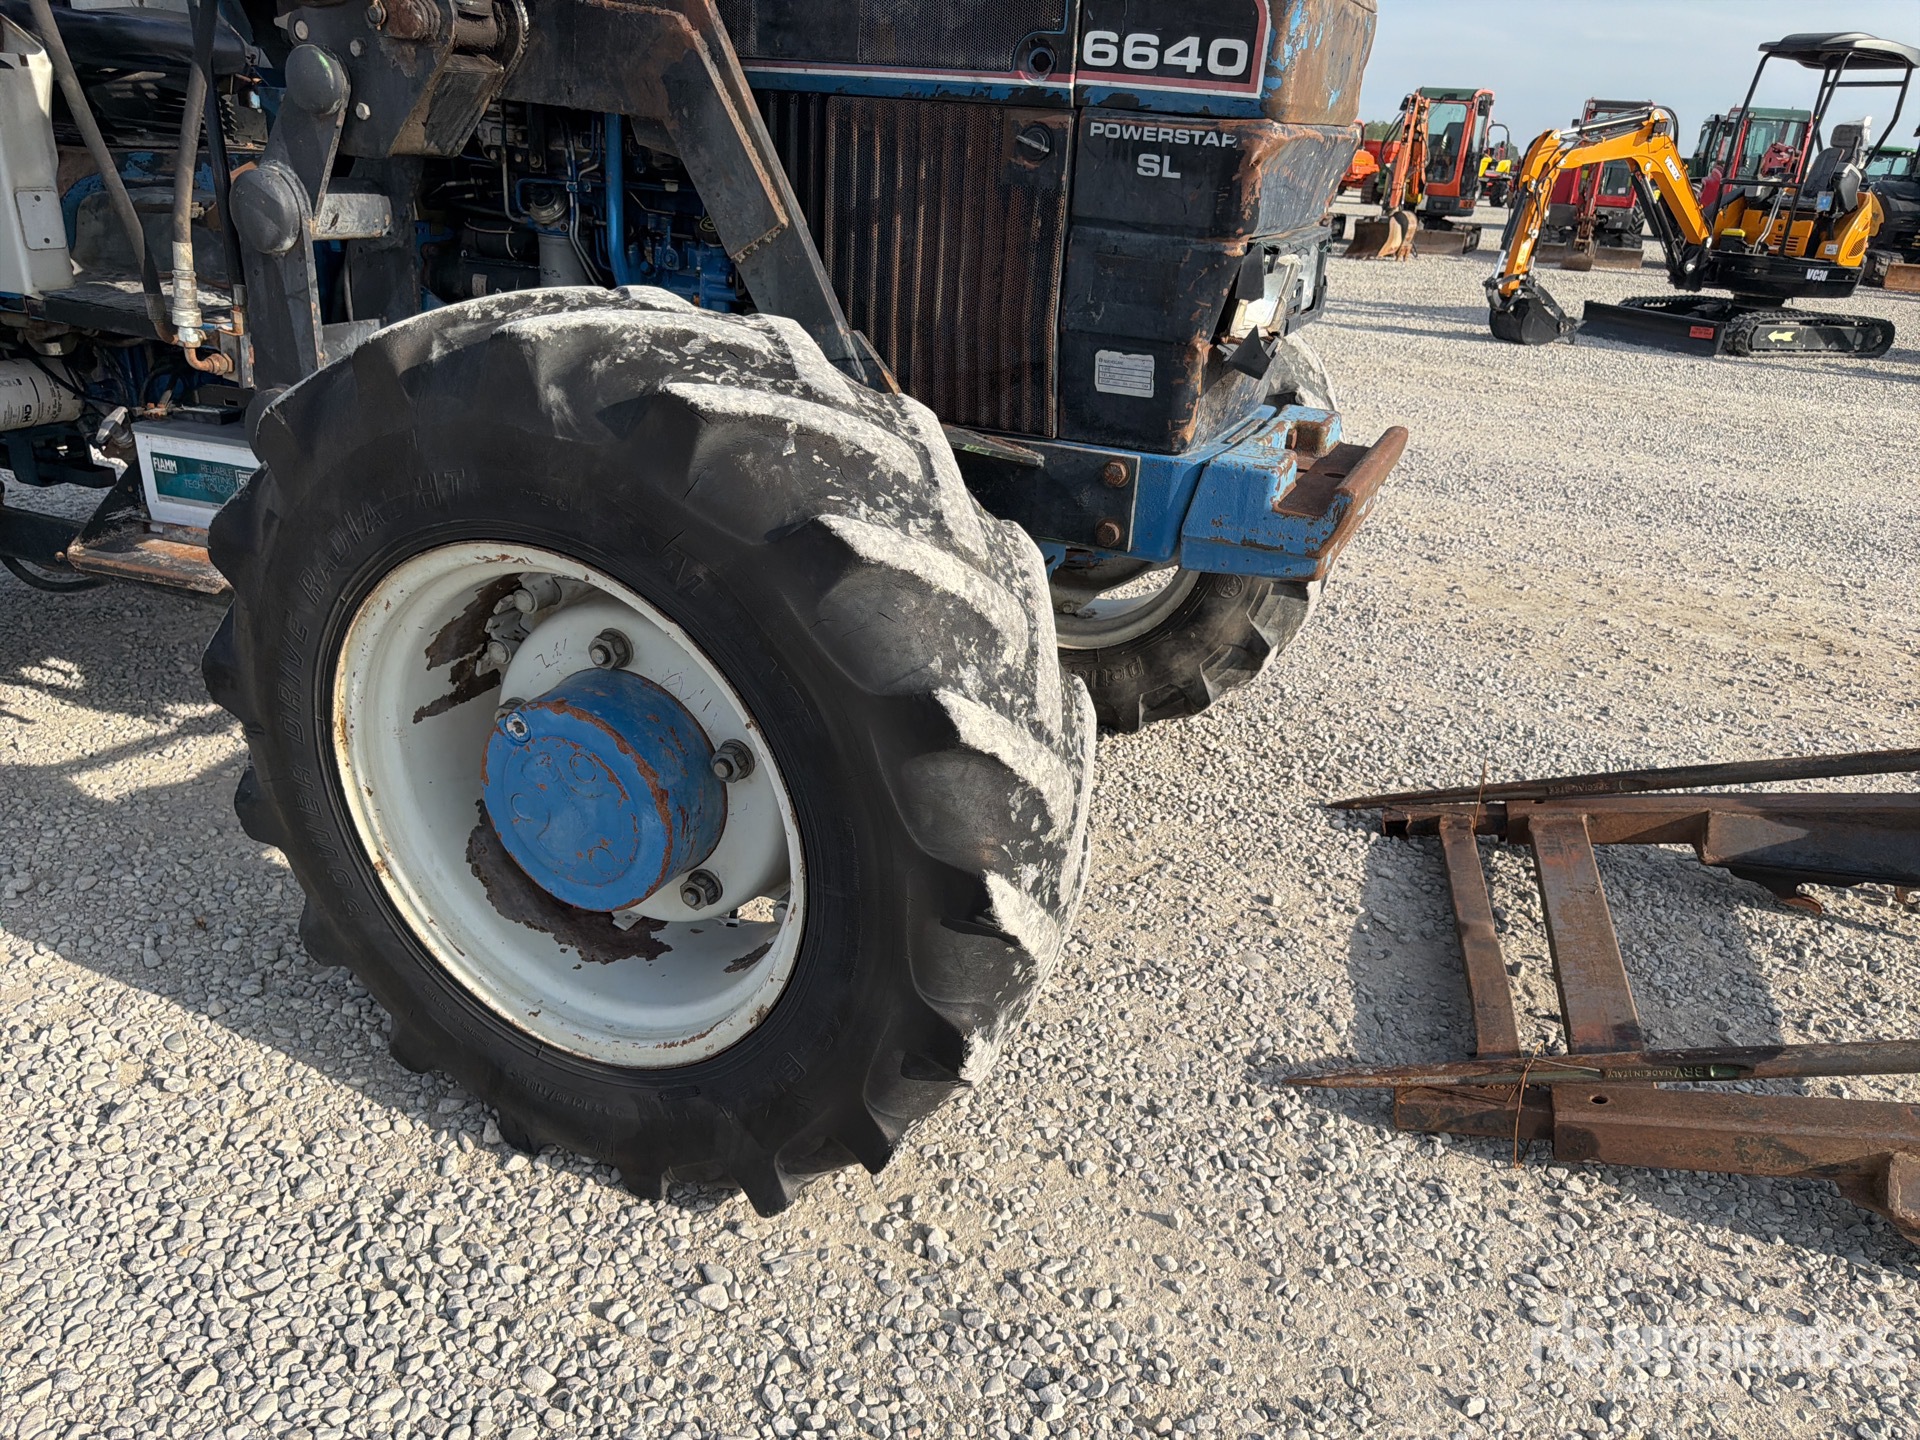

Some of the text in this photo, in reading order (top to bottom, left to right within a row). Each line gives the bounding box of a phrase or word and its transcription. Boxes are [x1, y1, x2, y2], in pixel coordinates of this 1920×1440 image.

[1082, 30, 1249, 77] 6640
[1089, 122, 1237, 149] POWERSTAR
[1136, 154, 1181, 179] SL
[153, 457, 178, 471] FIAMM
[200, 463, 235, 477] RELIABLE
[278, 610, 311, 746] DRIVE
[1633, 1069, 1644, 1077] IN
[1645, 1068, 1673, 1077] MADE
